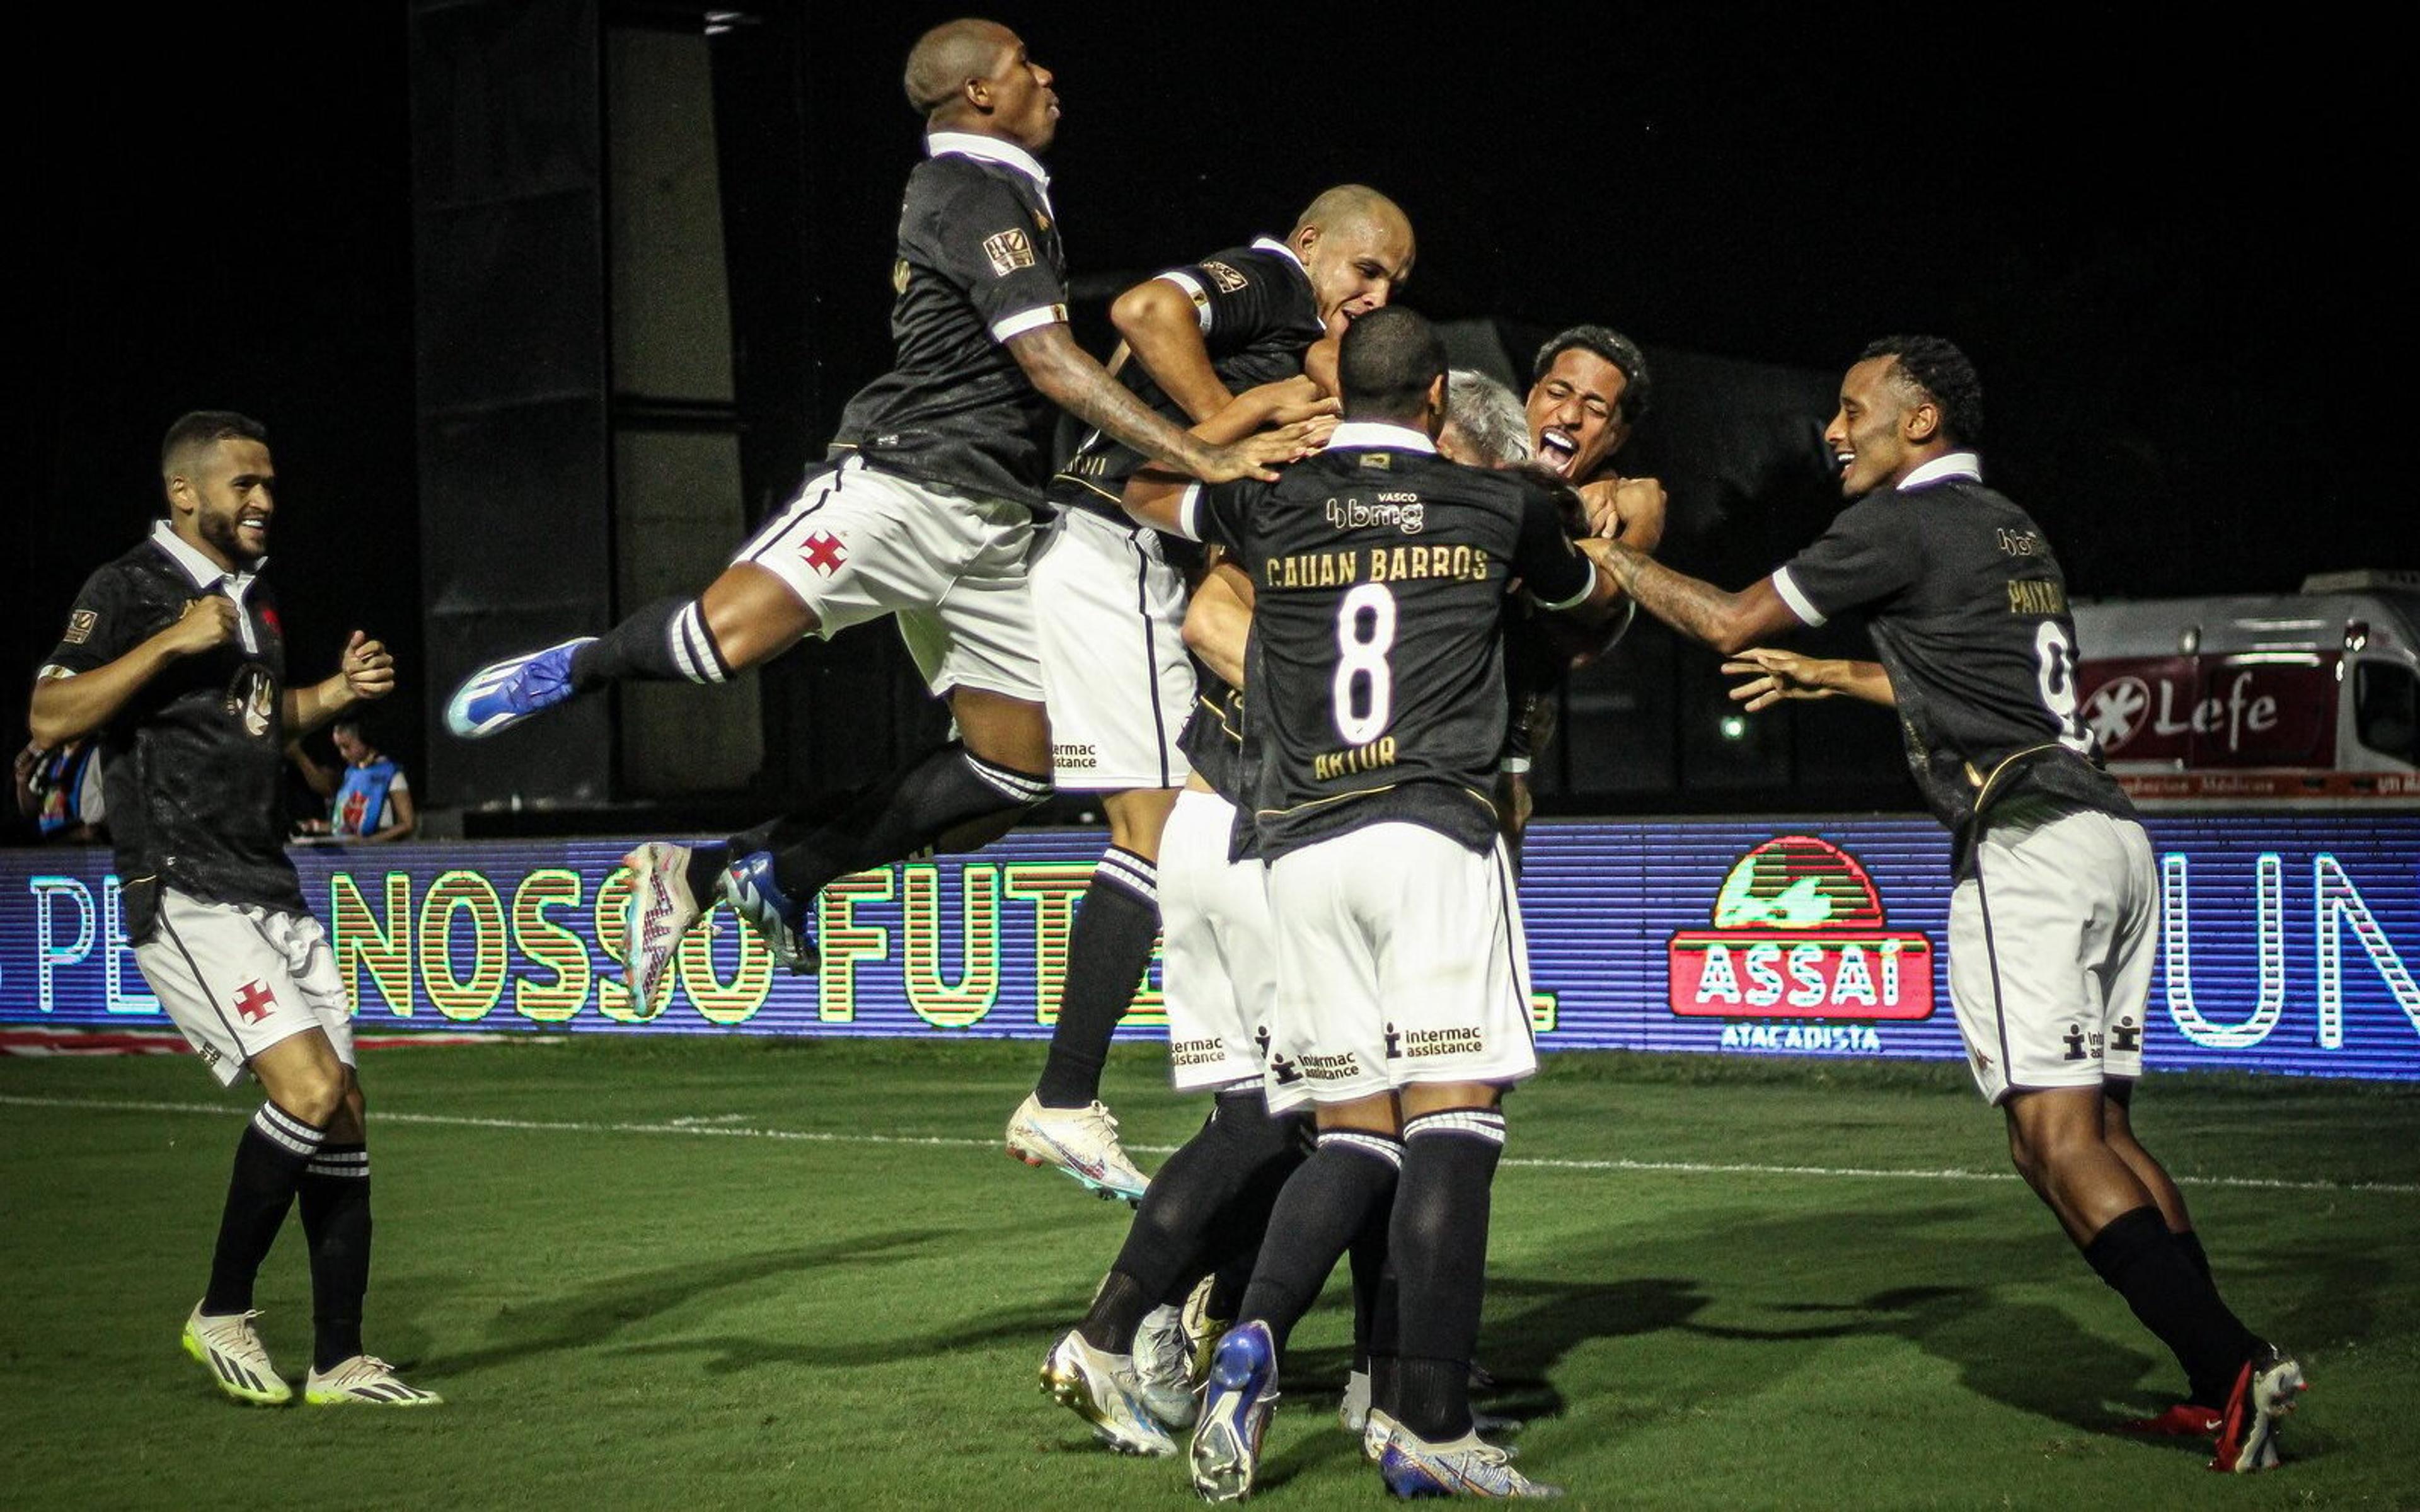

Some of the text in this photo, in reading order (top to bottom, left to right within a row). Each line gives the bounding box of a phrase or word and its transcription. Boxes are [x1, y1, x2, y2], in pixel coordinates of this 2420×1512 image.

[1378, 493, 1417, 502] VASCO
[1265, 546, 1487, 587] CAUAN BARROS
[1335, 582, 1396, 744] 8
[2154, 672, 2278, 752] Lefe
[1054, 745, 1096, 755] ermac
[1055, 757, 1097, 767] stance
[1406, 1027, 1481, 1044] intermac
[1720, 1022, 1882, 1053] ATACADISTA
[1407, 1041, 1483, 1058] assistance
